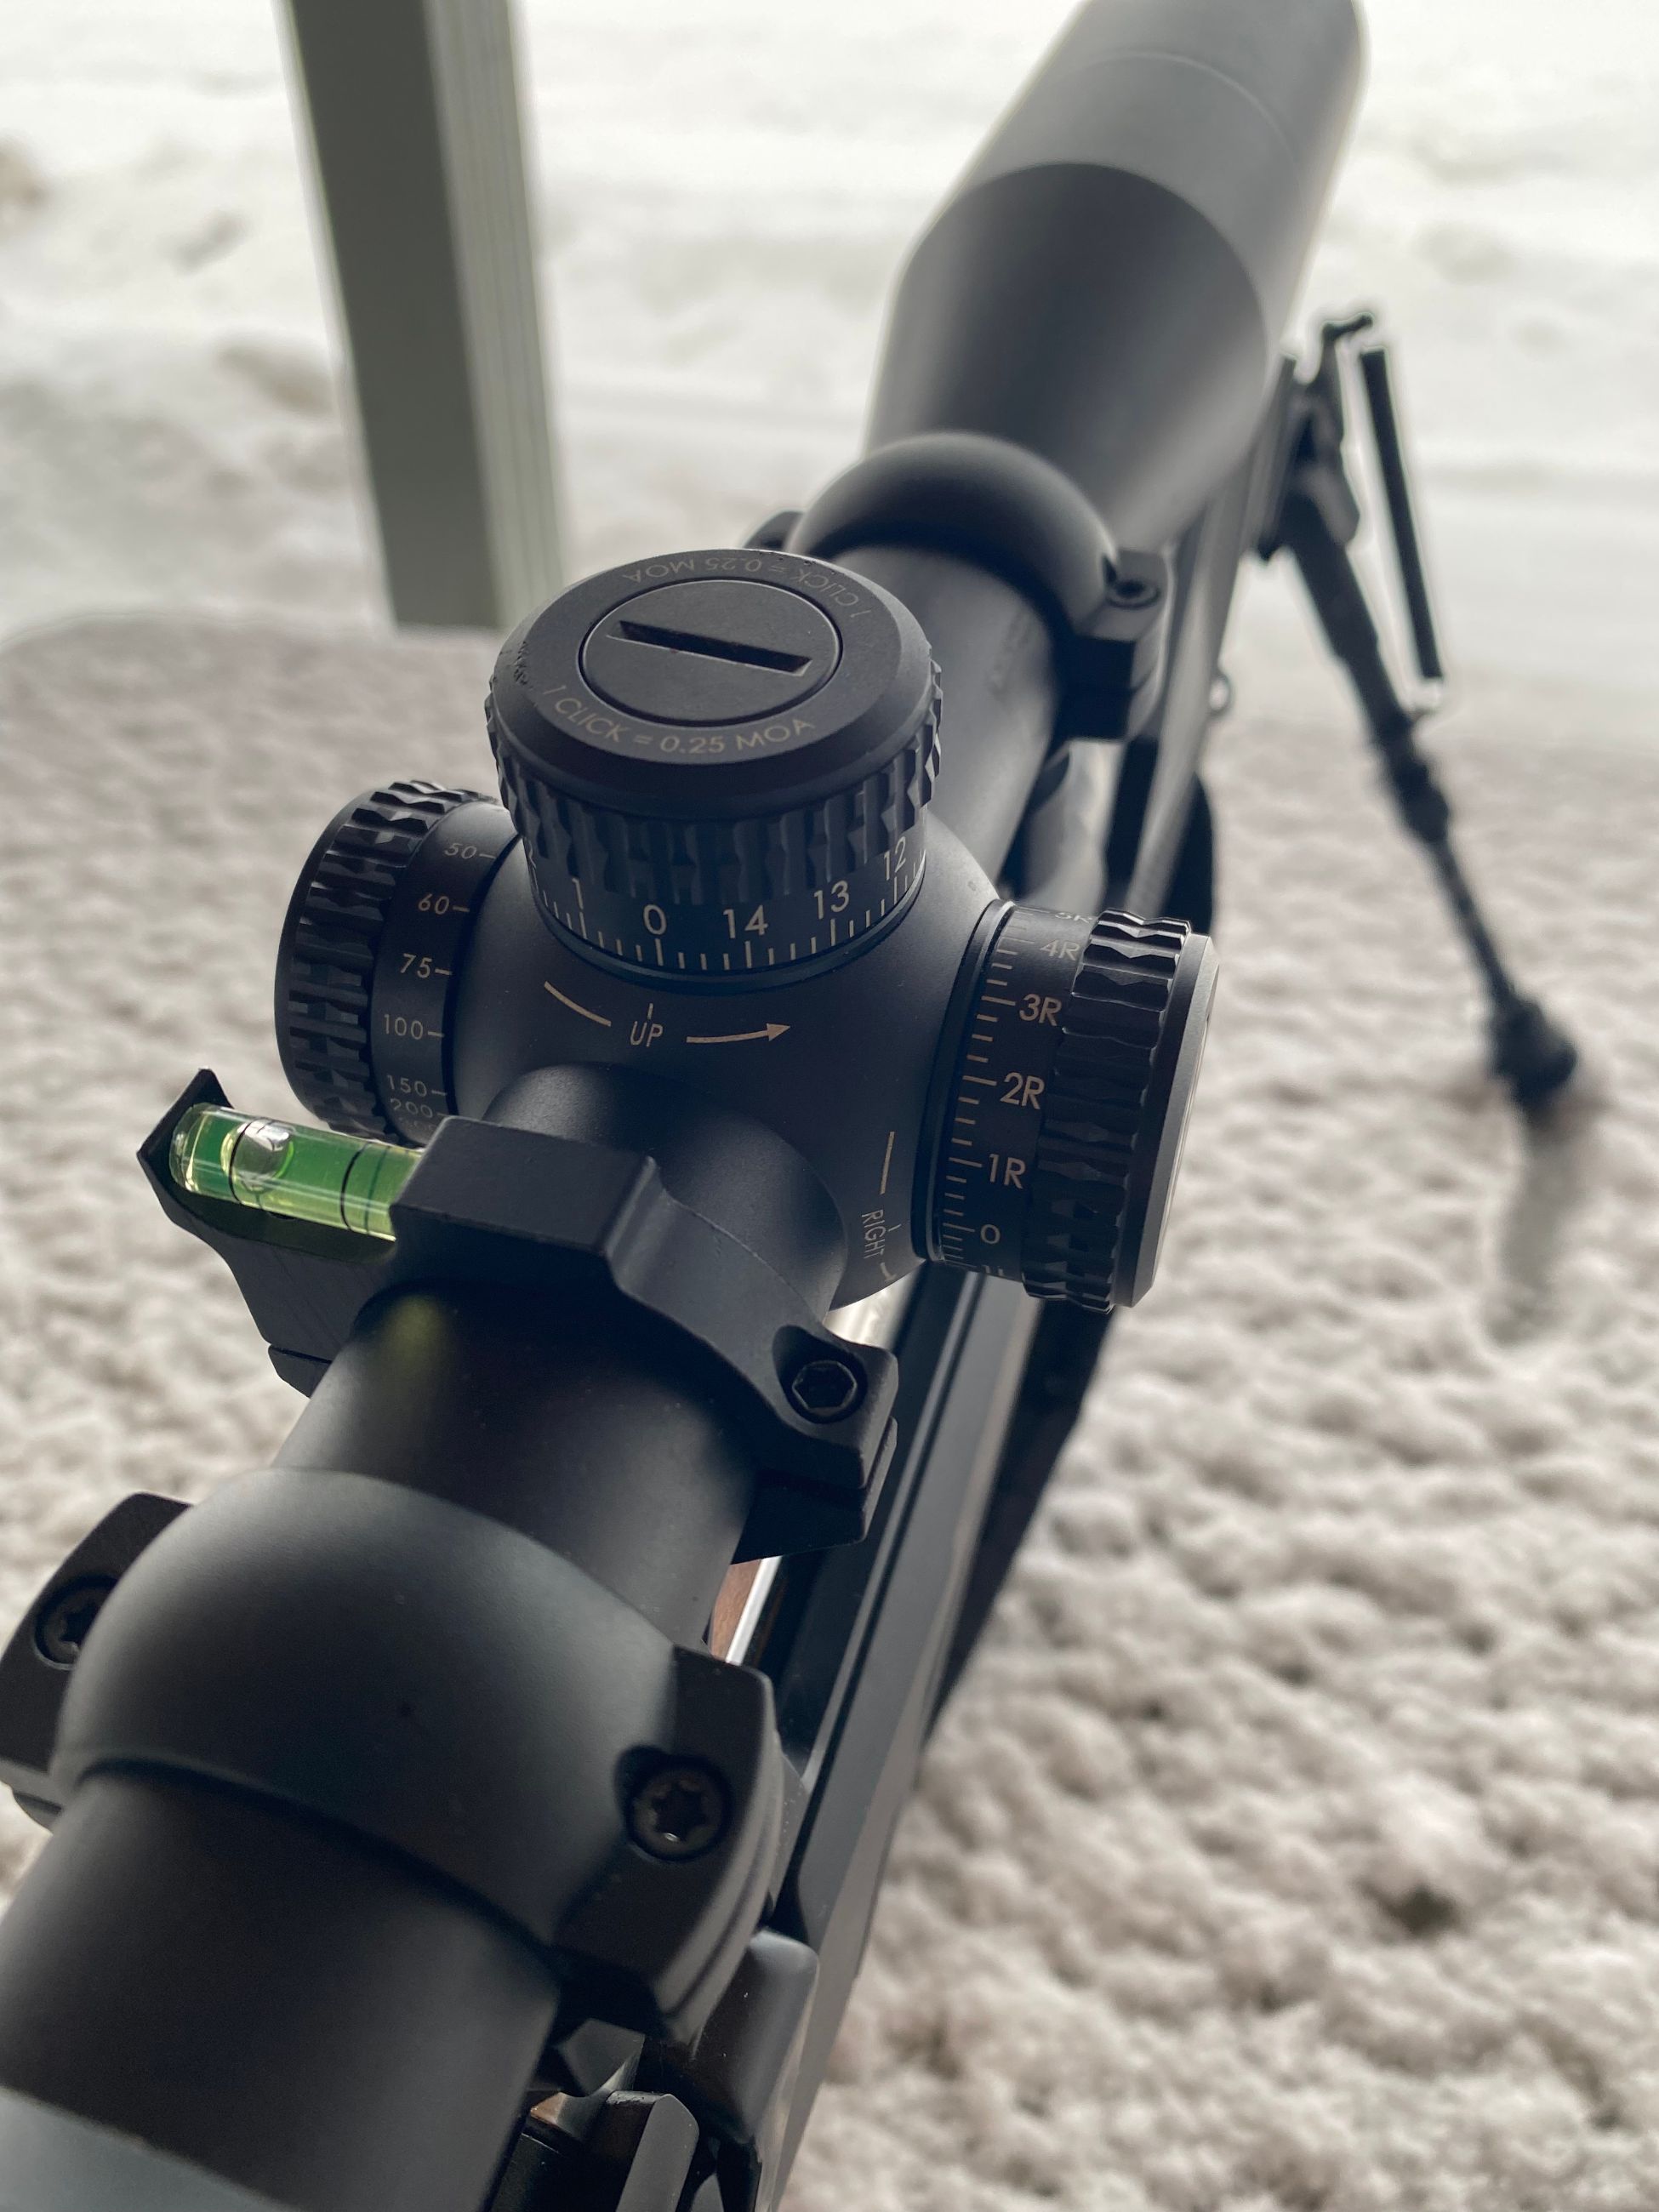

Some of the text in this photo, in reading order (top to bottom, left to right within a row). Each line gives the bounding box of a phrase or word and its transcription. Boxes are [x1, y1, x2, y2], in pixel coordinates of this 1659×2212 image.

[623, 559, 695, 583] MOA
[705, 557, 762, 572] 0.25
[792, 569, 858, 606] CLICK
[556, 698, 630, 743] CLICK
[633, 734, 653, 745] =
[660, 735, 724, 754] 0.25
[736, 718, 815, 751] MOA
[444, 842, 477, 860] 50
[883, 836, 907, 881] 12
[418, 893, 450, 915] 60
[572, 877, 584, 909] 1
[813, 880, 850, 920] 13
[643, 904, 667, 935] 0
[723, 904, 768, 938] 14
[400, 953, 432, 978] 75
[1040, 939, 1080, 961] 4R
[1019, 994, 1062, 1026] 3R
[384, 1014, 424, 1040] 100
[630, 1020, 664, 1047] UP
[386, 1074, 427, 1097] 150
[1000, 1072, 1045, 1109] 2R
[989, 1153, 1027, 1189] 1R
[861, 1209, 887, 1259] RIGHT
